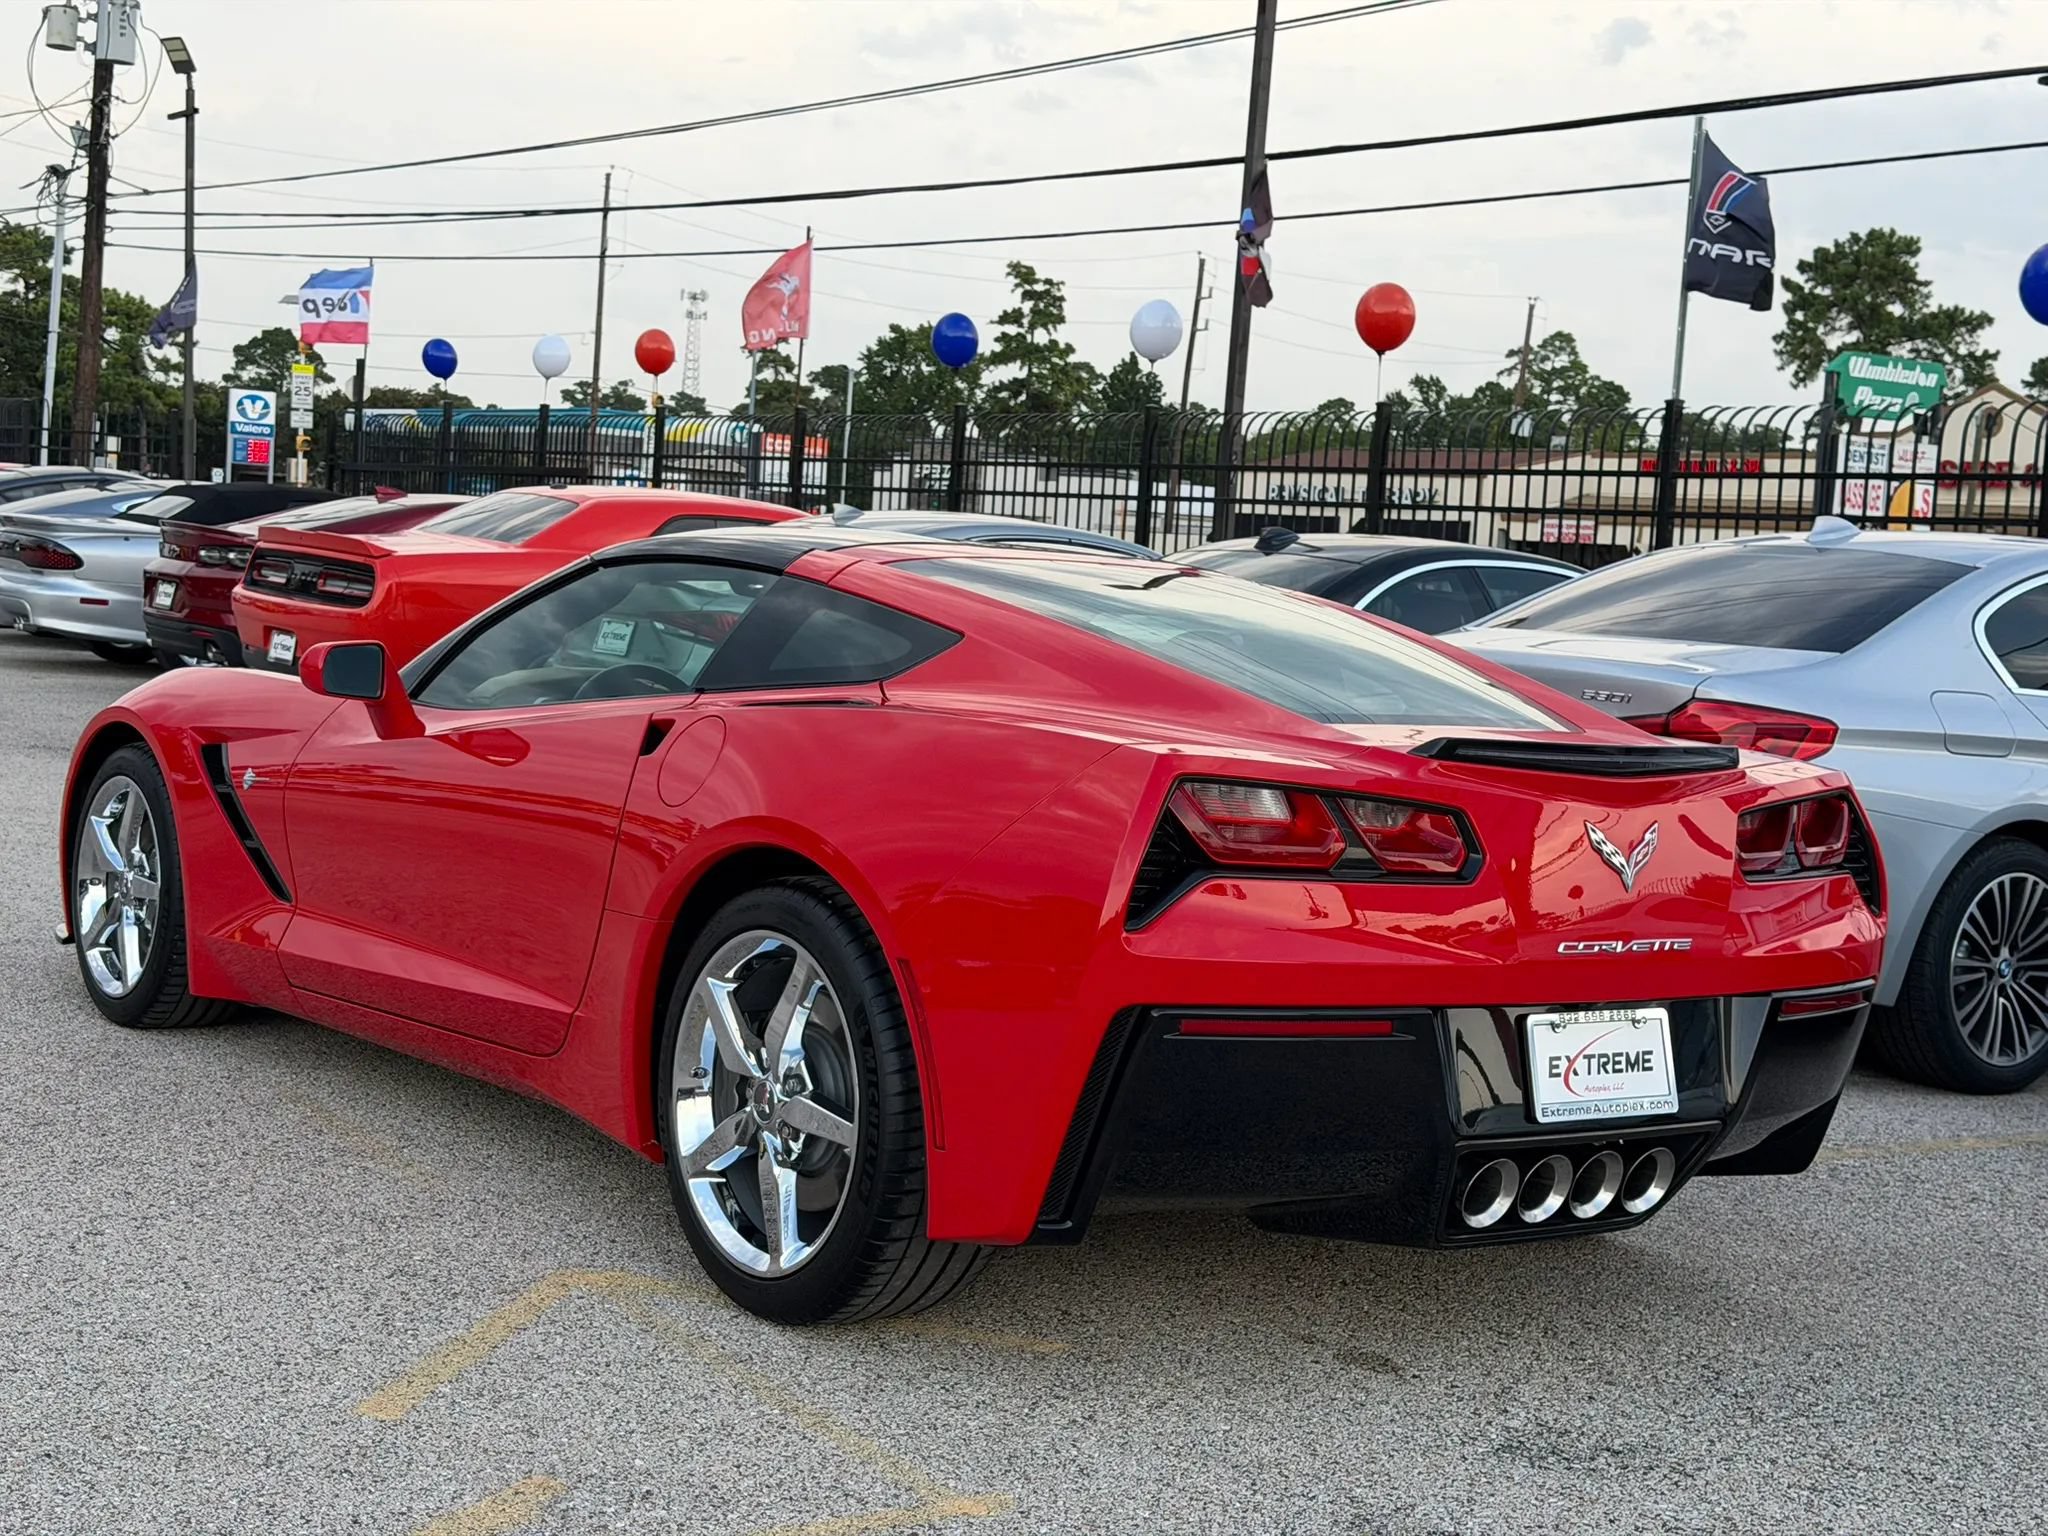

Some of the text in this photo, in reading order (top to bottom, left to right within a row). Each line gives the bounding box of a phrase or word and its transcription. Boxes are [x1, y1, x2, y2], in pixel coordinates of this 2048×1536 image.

[1848, 355, 1939, 388] Wimbledon
[294, 386, 312, 397] 25
[1853, 385, 1904, 413] Plaza
[234, 423, 271, 434] Valero
[1358, 487, 1441, 504] TRAPY
[1840, 481, 1882, 512] ASSGE
[1581, 688, 1633, 704] 530i
[1557, 937, 1693, 955] CORVETTE
[1548, 1050, 1654, 1079] EXTREME
[1612, 1082, 1625, 1091] LLC
[1541, 1098, 1674, 1118] ExtremeAutoplex.com
